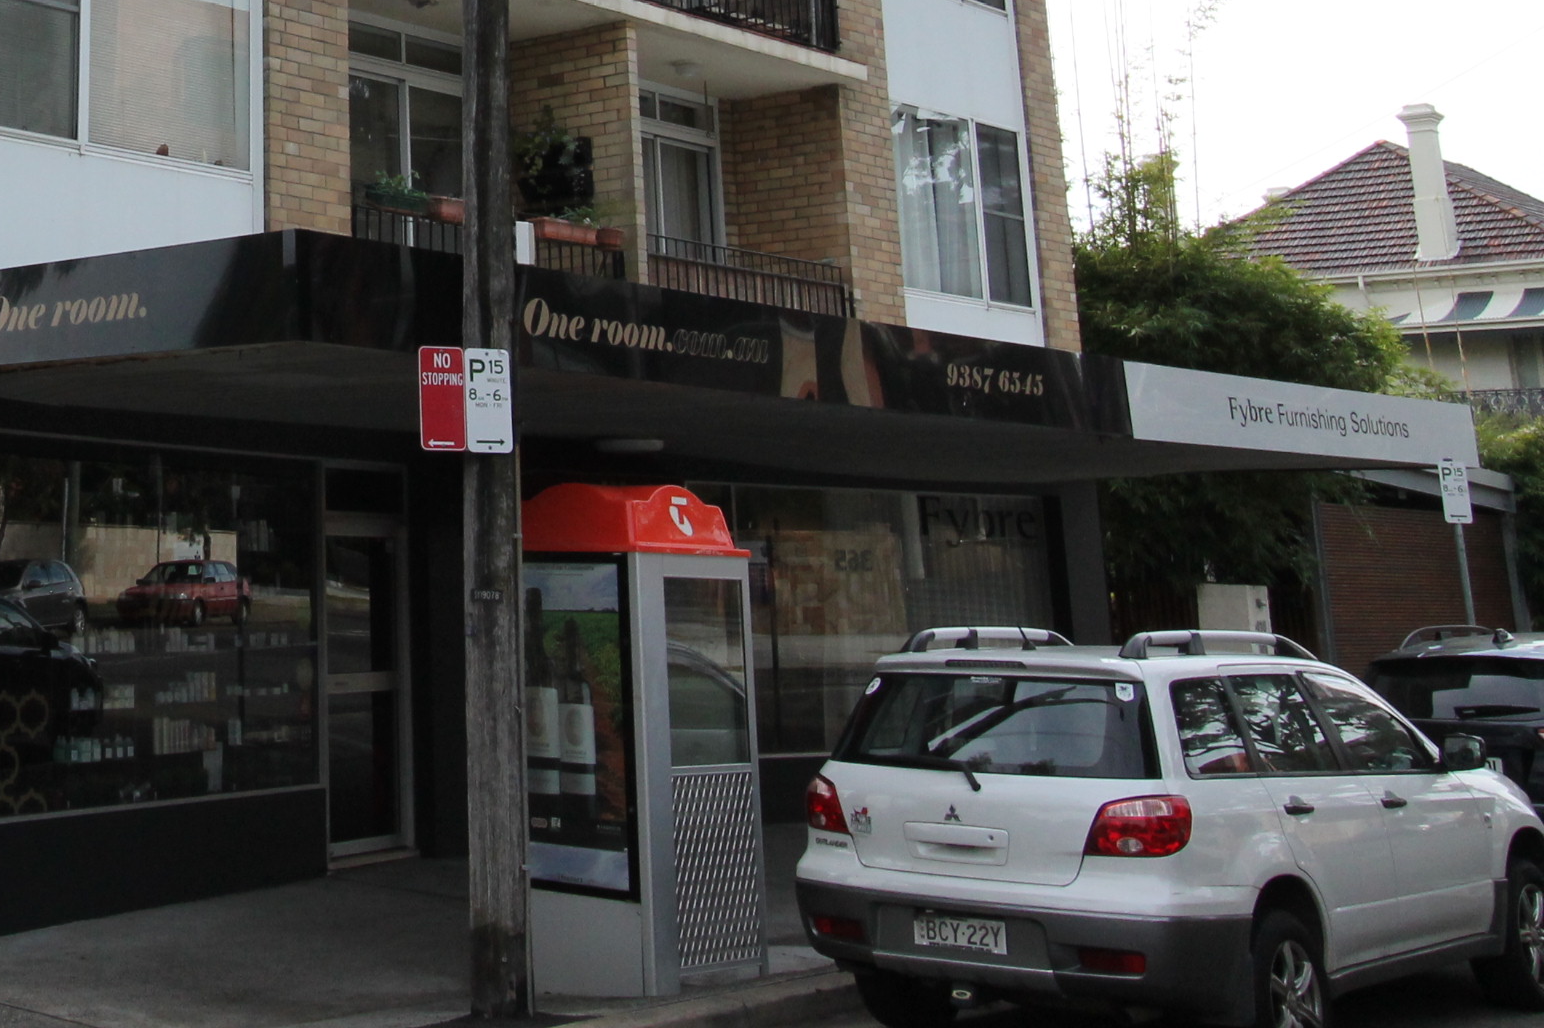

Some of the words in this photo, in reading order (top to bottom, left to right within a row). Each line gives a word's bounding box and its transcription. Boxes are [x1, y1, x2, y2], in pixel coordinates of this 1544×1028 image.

[51, 292, 147, 327] room.
[523, 297, 585, 341] One
[433, 352, 451, 369] NO
[421, 372, 463, 386] STOPPING
[946, 363, 994, 394] 9387
[998, 369, 1044, 396] 6545
[1227, 396, 1274, 427] Fybre
[1277, 403, 1347, 437] Furnishing
[1349, 411, 1410, 439] Solutions
[918, 496, 1039, 548] Fybre
